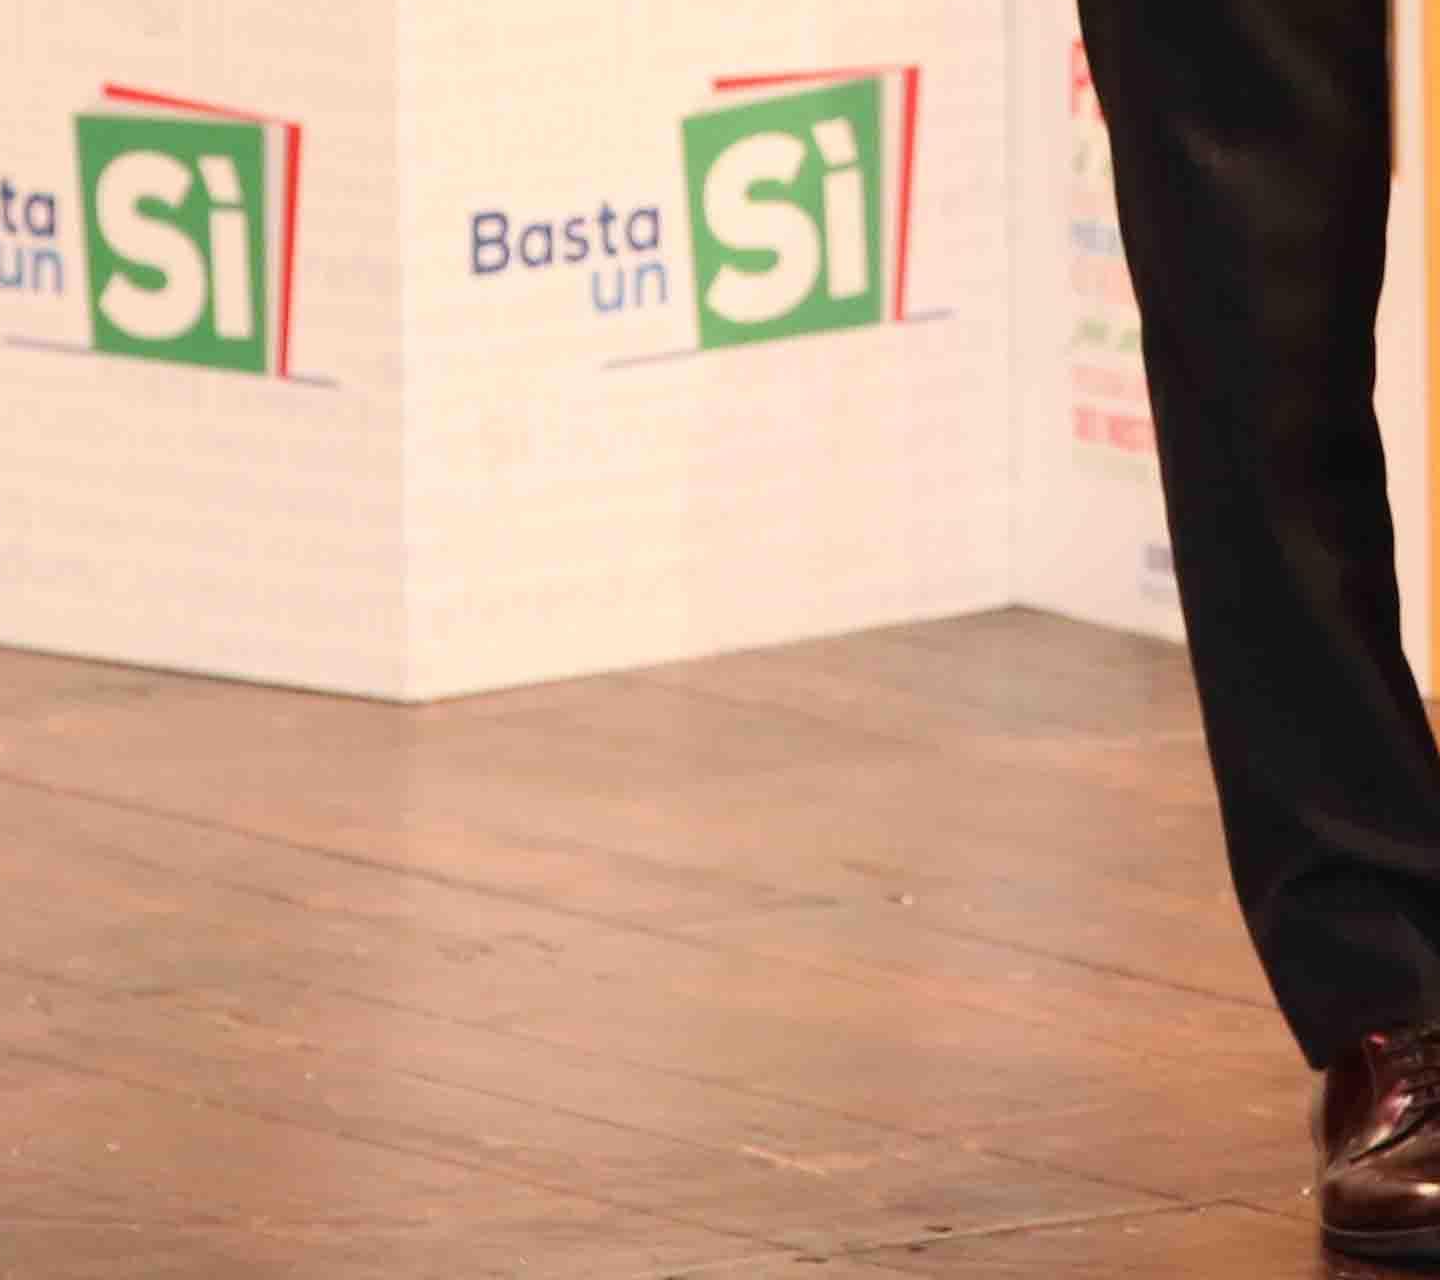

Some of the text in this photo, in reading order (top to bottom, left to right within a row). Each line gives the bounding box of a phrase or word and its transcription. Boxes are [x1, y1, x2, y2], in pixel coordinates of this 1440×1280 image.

[96, 148, 253, 340] Sì
[468, 200, 665, 279] Basta
[589, 255, 670, 314] un
[703, 116, 869, 323] Sì
